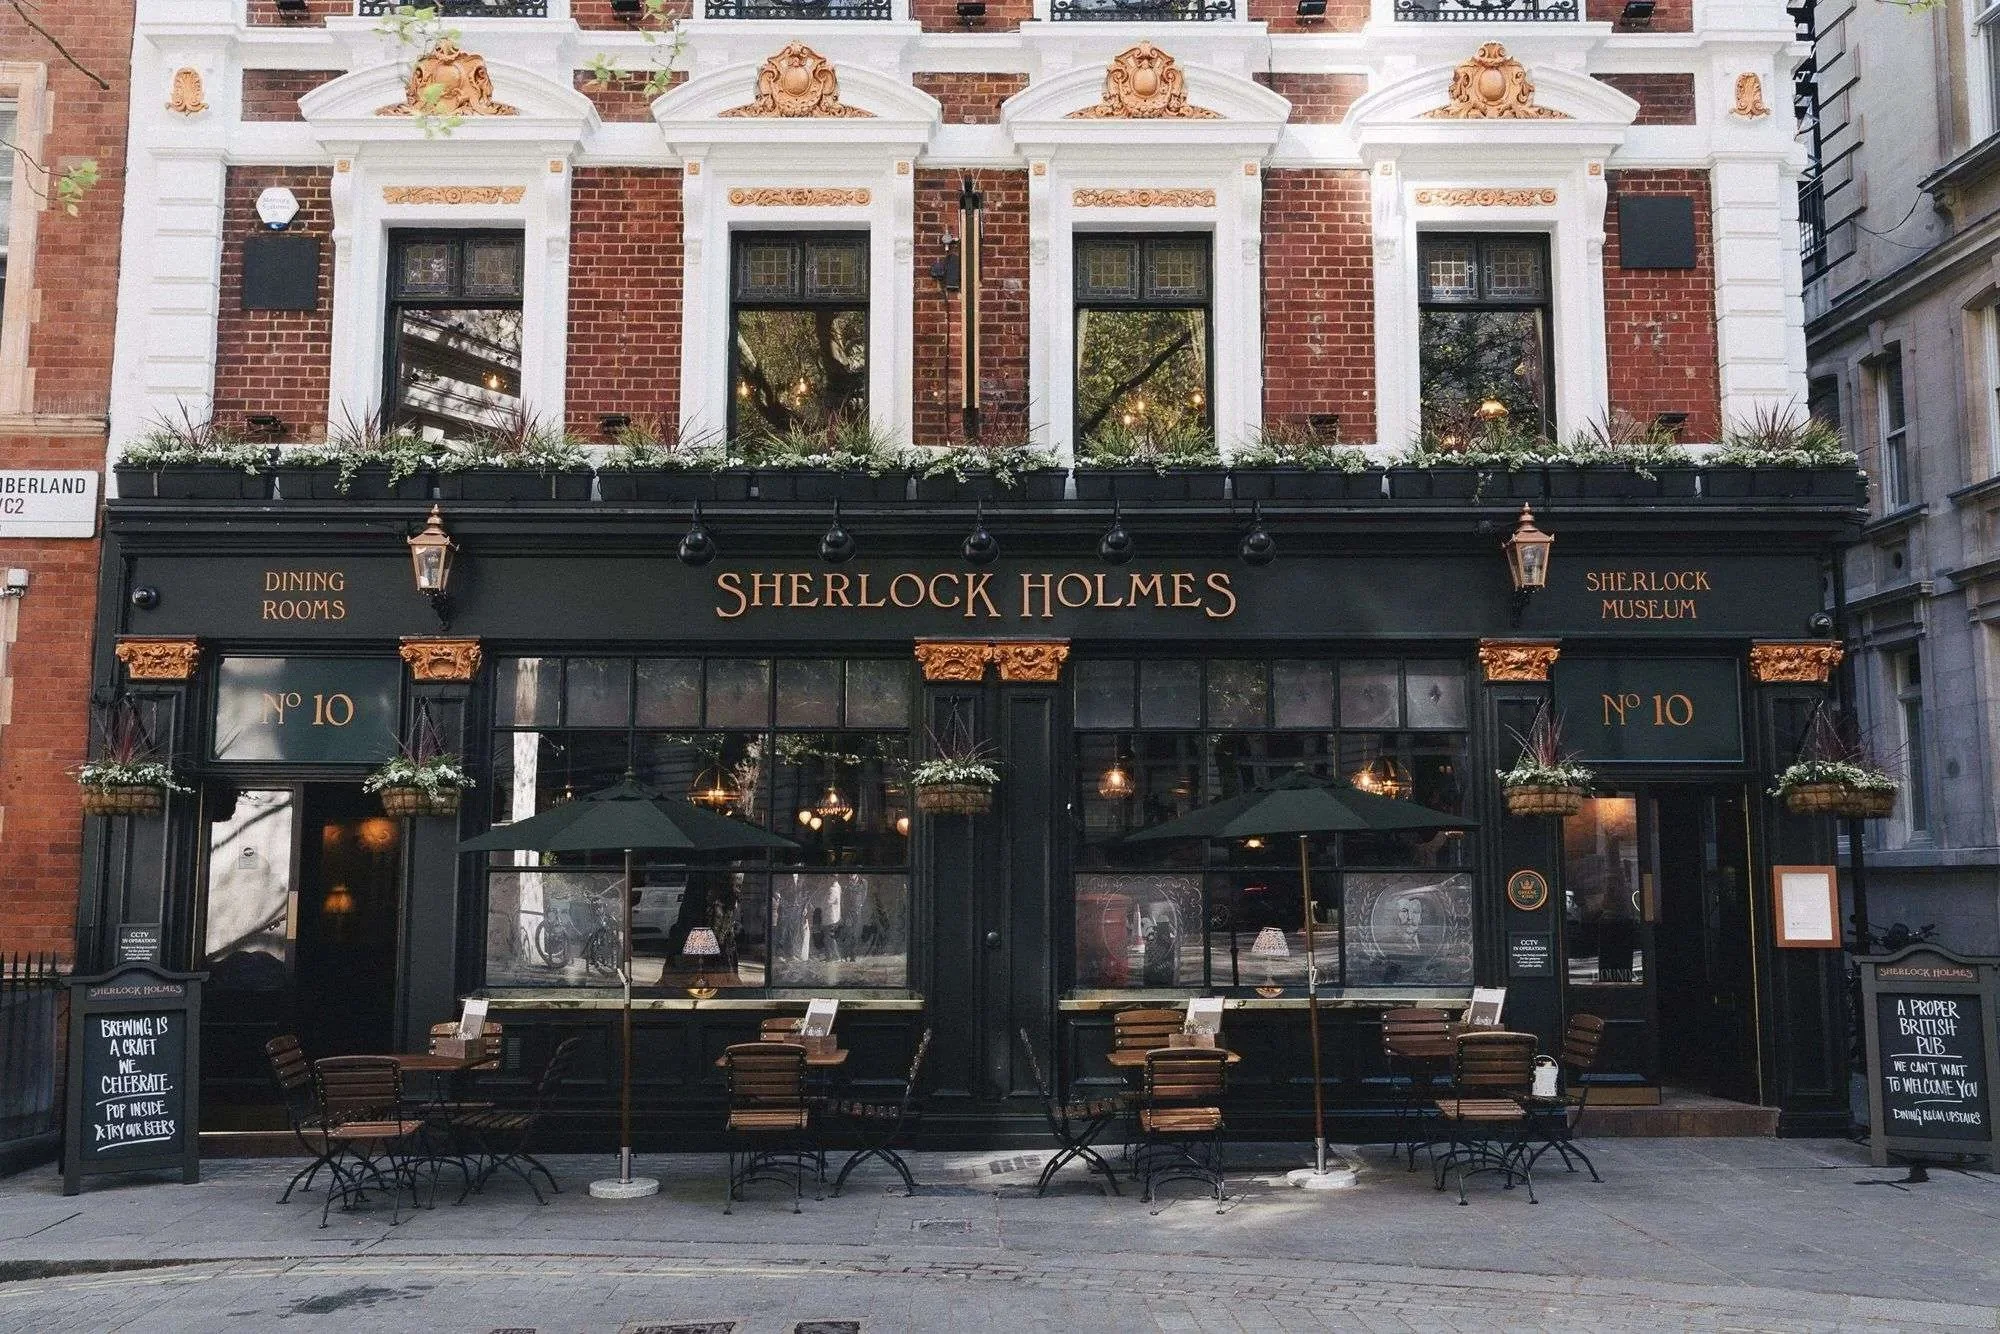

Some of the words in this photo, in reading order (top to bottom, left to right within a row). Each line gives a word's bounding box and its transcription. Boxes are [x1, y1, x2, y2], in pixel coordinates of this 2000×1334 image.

[0, 477, 86, 494] BERLAND
[0, 498, 24, 514] C2
[265, 571, 345, 592] DINING
[1586, 571, 1712, 592] SHERLOCK
[716, 572, 1001, 618] SHERLOCK
[1020, 572, 1237, 618] HOLMES
[262, 600, 346, 620] ROOMS
[1601, 599, 1698, 619] MUSEUM
[312, 693, 354, 727] 10
[1652, 693, 1694, 727] 10
[1880, 967, 1930, 977] SHERLOCK
[1933, 967, 1974, 978] HOLMES
[90, 986, 142, 997] SHERLOCK
[144, 984, 182, 995] HOLMES
[1897, 999, 1906, 1016] A
[1910, 999, 1960, 1019] PROPER
[101, 1017, 153, 1038] BREWING
[156, 1016, 168, 1035] IS
[1900, 1017, 1957, 1036] BRITISH
[109, 1039, 120, 1057] A
[122, 1038, 157, 1056] CRAFT
[1916, 1035, 1946, 1055] PUB
[119, 1058, 141, 1075] WE
[1894, 1060, 1907, 1072] WE
[1910, 1061, 1938, 1076] CAN'T
[1940, 1063, 1968, 1077] WAIT
[1885, 1076, 1900, 1093] TO
[1902, 1077, 1956, 1096] WELCOME
[1955, 1079, 1978, 1099] YOU
[106, 1103, 126, 1121] POP
[130, 1100, 169, 1117] INSIDE
[1892, 1108, 1923, 1126] DINING
[144, 1120, 175, 1136] BEERS
